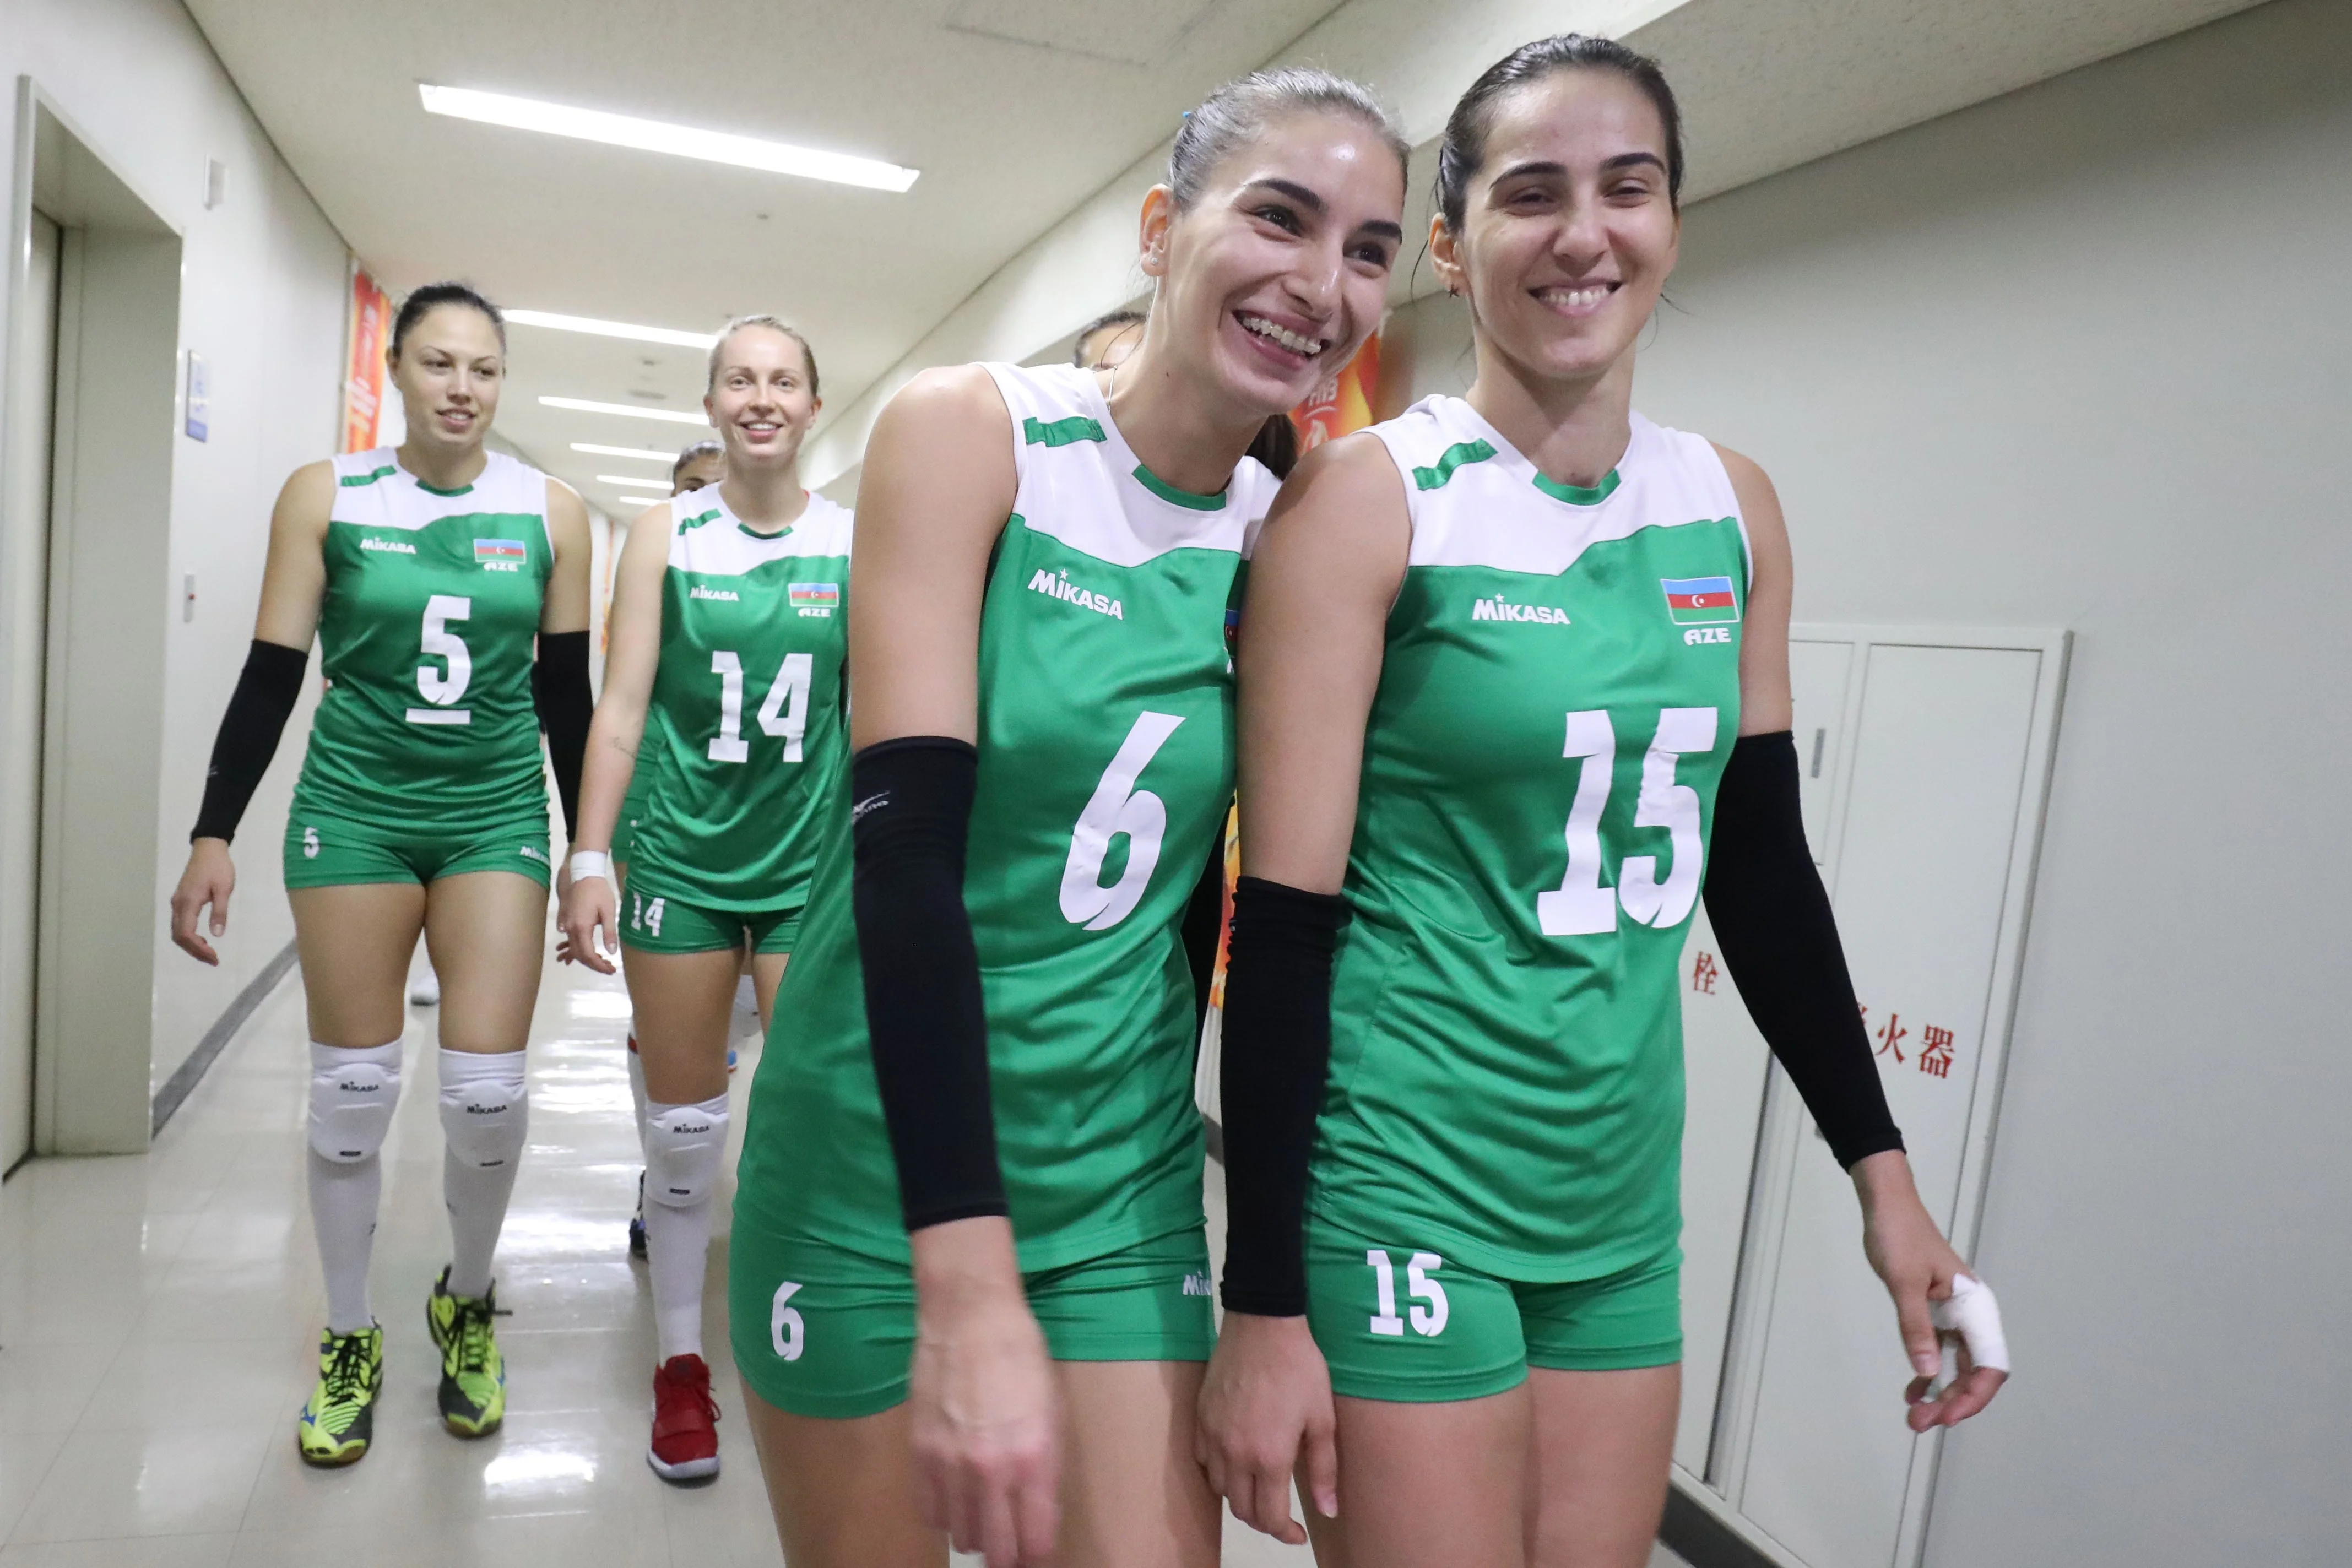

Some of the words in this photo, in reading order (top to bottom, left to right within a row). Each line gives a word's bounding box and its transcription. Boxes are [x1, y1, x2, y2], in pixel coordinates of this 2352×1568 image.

[416, 595, 472, 706] 5
[798, 607, 831, 617] AZE
[1683, 628, 1732, 646] AZE
[708, 650, 813, 763] 14
[304, 827, 319, 858] 5
[1059, 710, 1186, 931] 6
[1537, 707, 1719, 936] 15
[631, 892, 665, 936] 14
[1854, 1002, 1954, 1078] 火器
[771, 1281, 804, 1361] 6
[1367, 1250, 1449, 1337] 15
